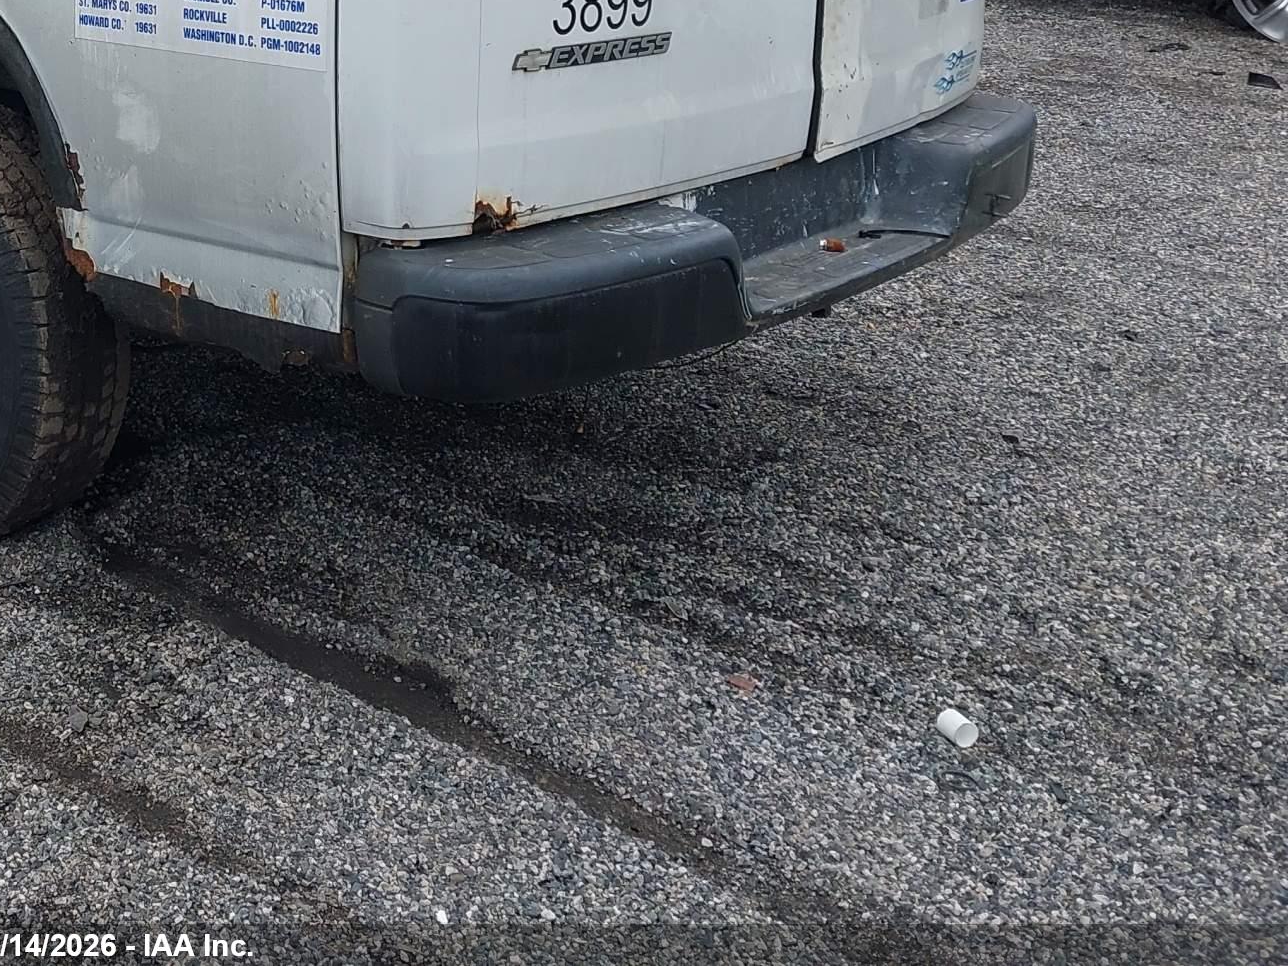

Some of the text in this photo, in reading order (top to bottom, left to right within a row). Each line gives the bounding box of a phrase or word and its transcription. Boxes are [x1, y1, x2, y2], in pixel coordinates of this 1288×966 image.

[119, 0, 132, 12] CO.
[135, 2, 157, 15] 19631
[79, 14, 157, 34] HOWARD CO. 19631
[183, 8, 319, 35] ROCKVILLE PLL-0002226
[183, 27, 321, 55] WASHINGTON D.C. PGM-1002148
[548, 33, 672, 68] EXPRESS
